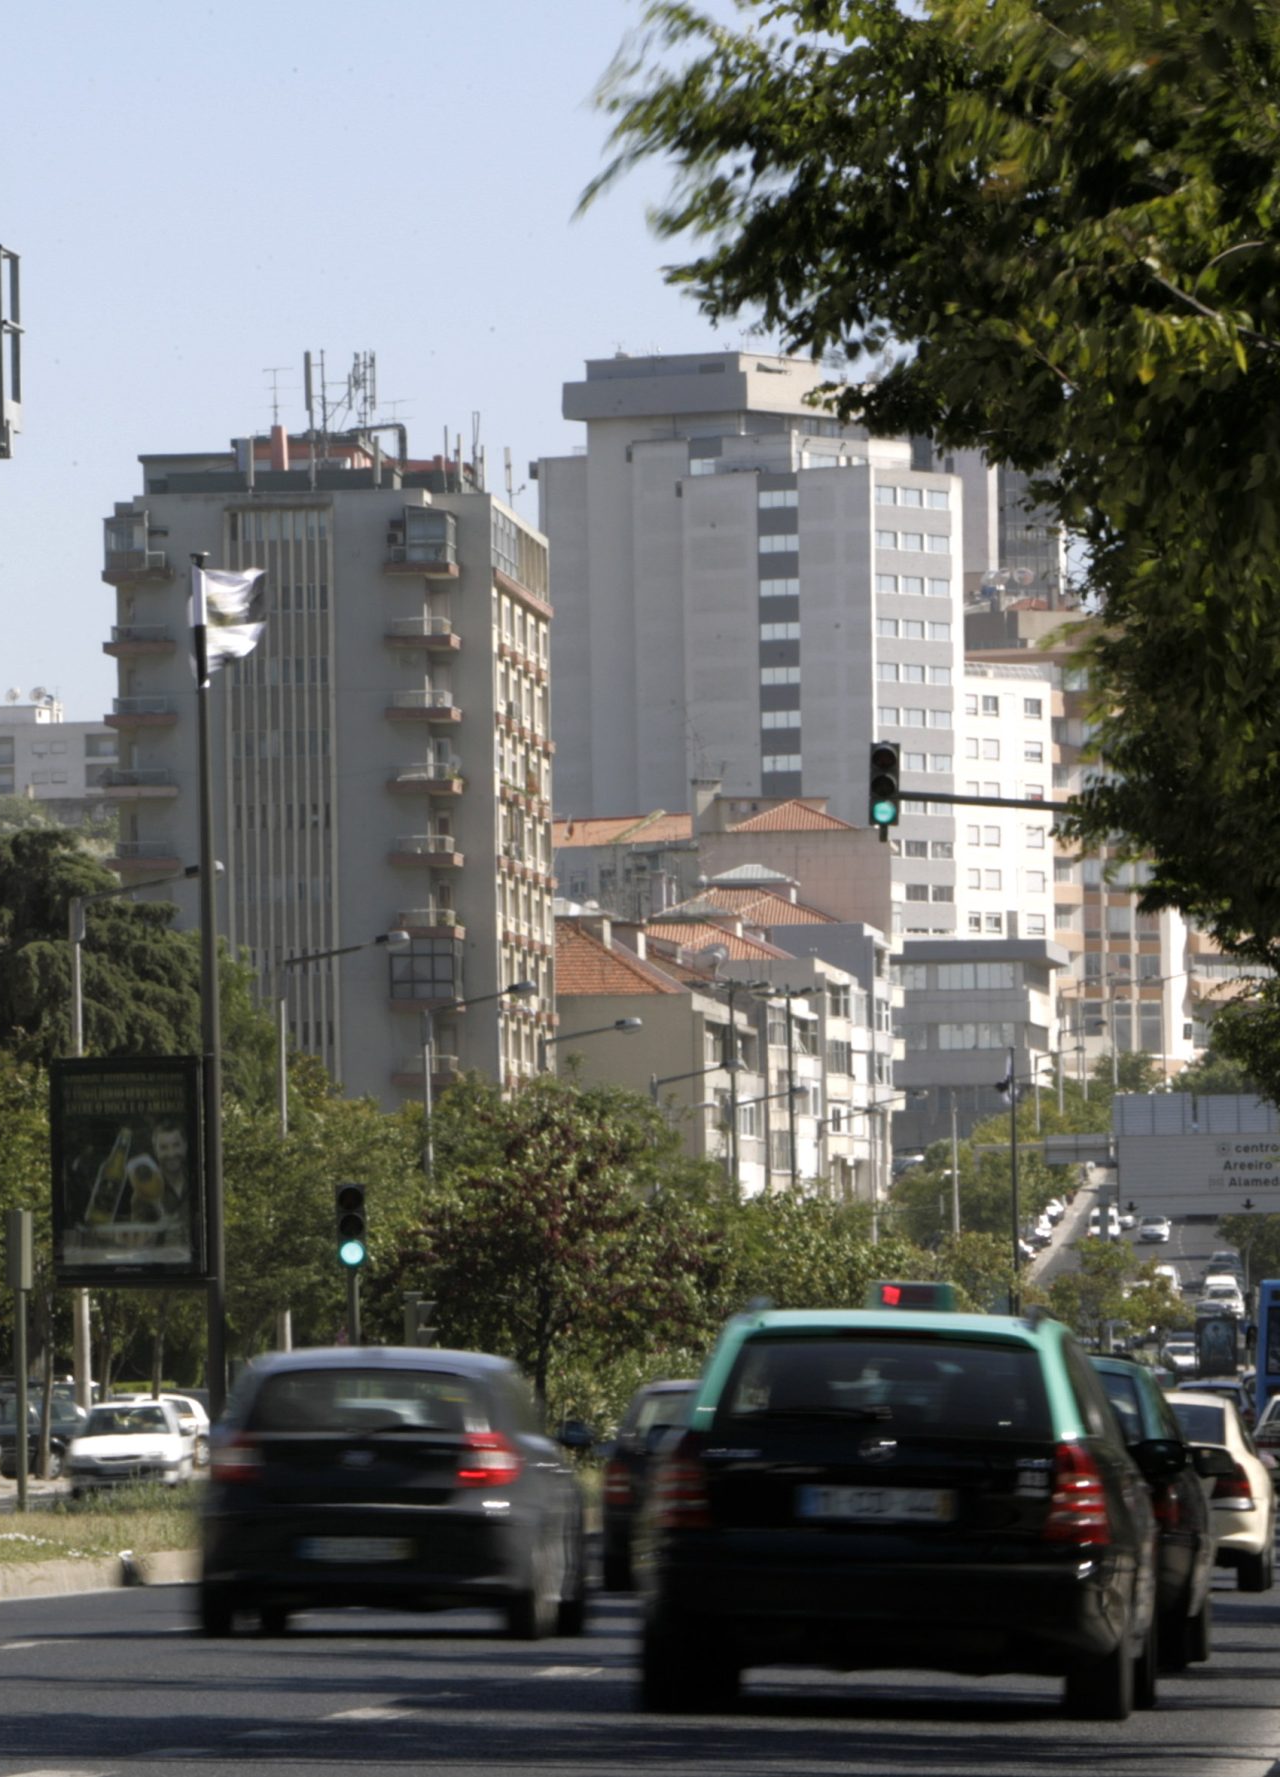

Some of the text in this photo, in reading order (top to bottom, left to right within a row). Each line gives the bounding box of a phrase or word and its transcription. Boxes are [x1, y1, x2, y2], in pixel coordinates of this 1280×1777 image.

[1235, 1142, 1280, 1154] centro
[1223, 1160, 1274, 1171] Areeiro
[1228, 1176, 1280, 1188] Alamed
